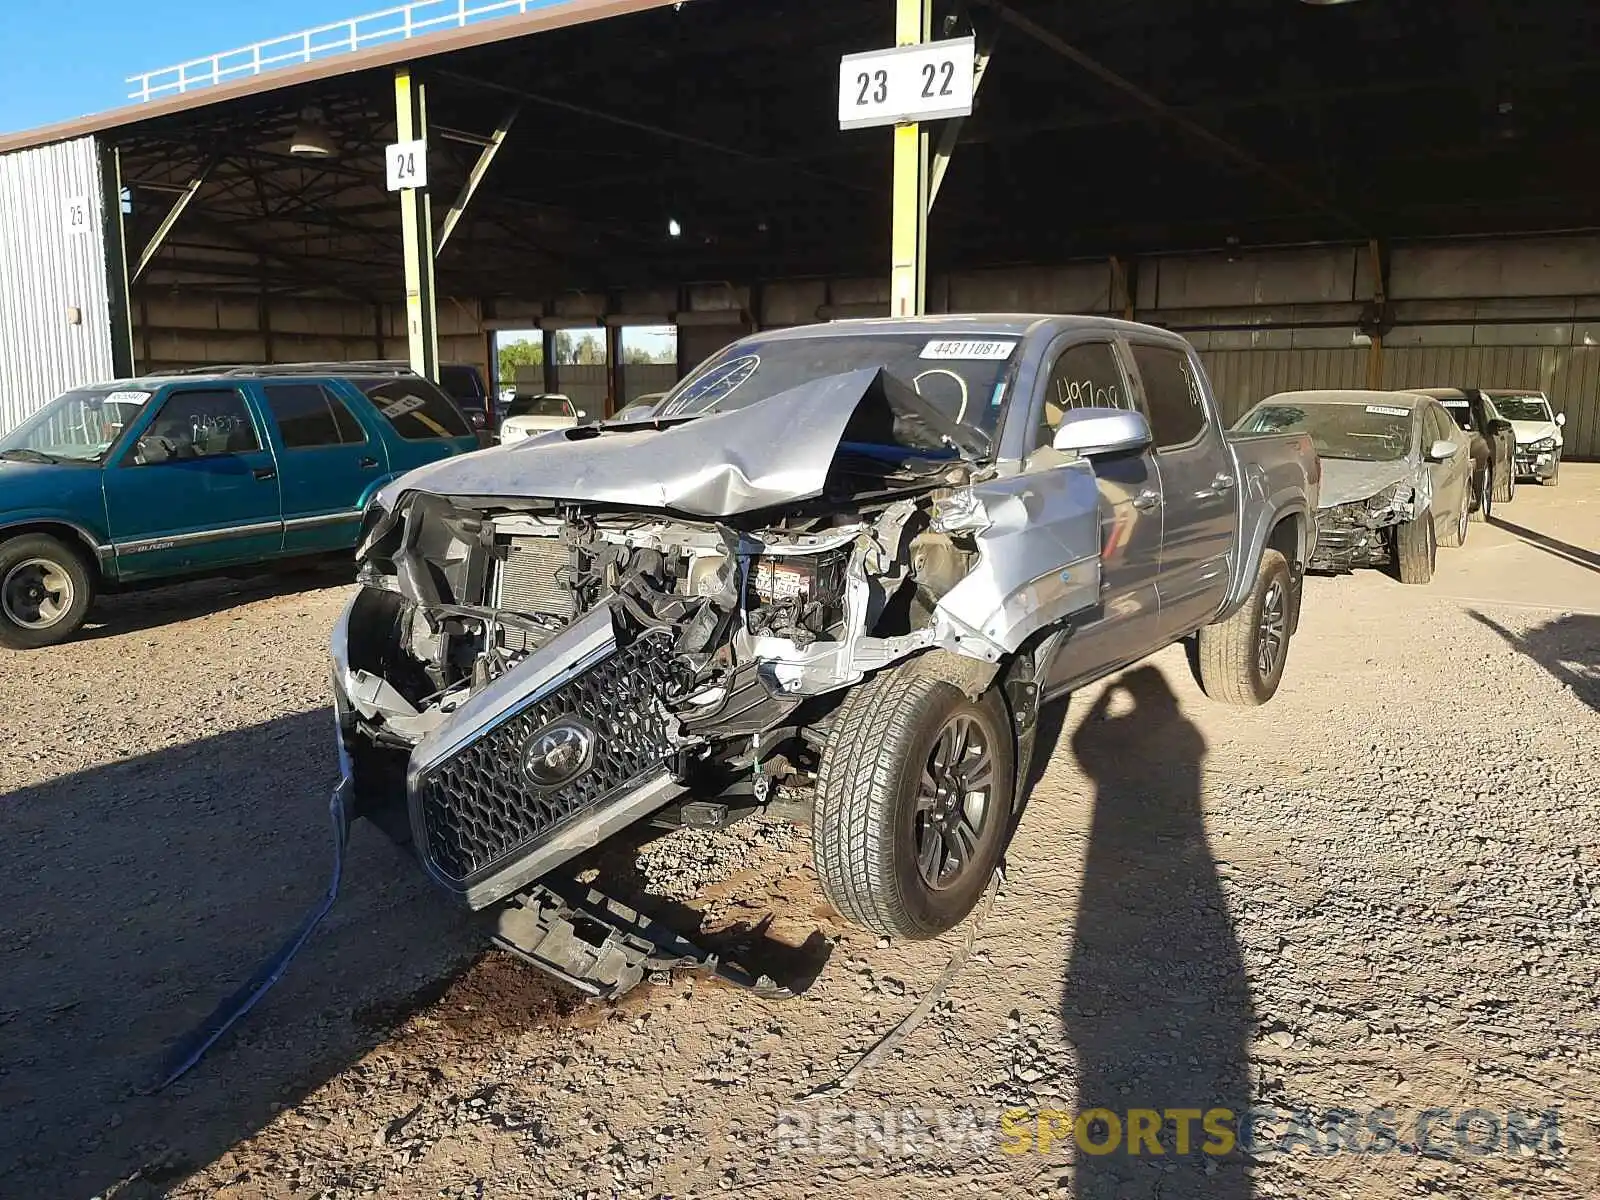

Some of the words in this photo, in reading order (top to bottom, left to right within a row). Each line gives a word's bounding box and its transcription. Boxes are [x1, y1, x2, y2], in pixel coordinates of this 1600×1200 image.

[856, 69, 888, 105] 23
[921, 61, 955, 98] 22
[397, 152, 415, 179] 24
[70, 205, 83, 226] 25
